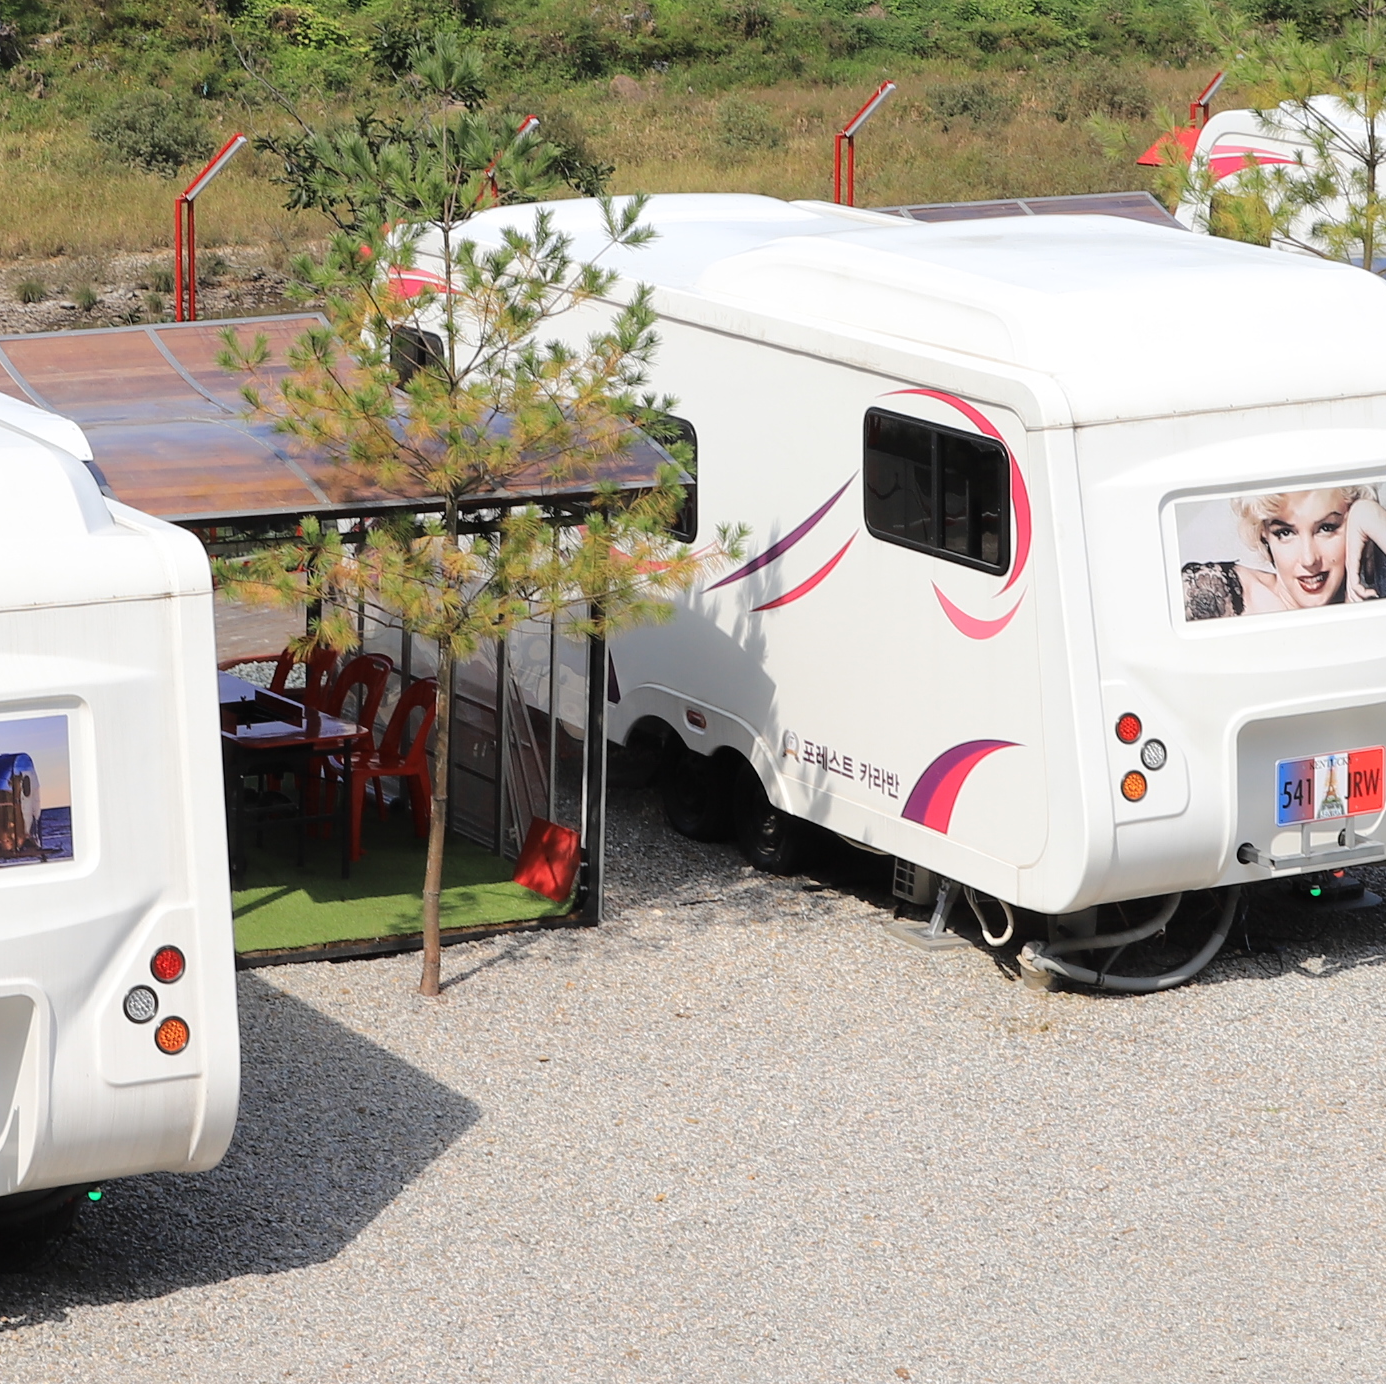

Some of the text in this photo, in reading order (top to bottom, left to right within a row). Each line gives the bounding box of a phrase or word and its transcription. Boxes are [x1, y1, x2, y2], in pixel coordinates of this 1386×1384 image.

[803, 739, 900, 799] 포레스트 카라반
[1282, 768, 1381, 809] 541 JRW
